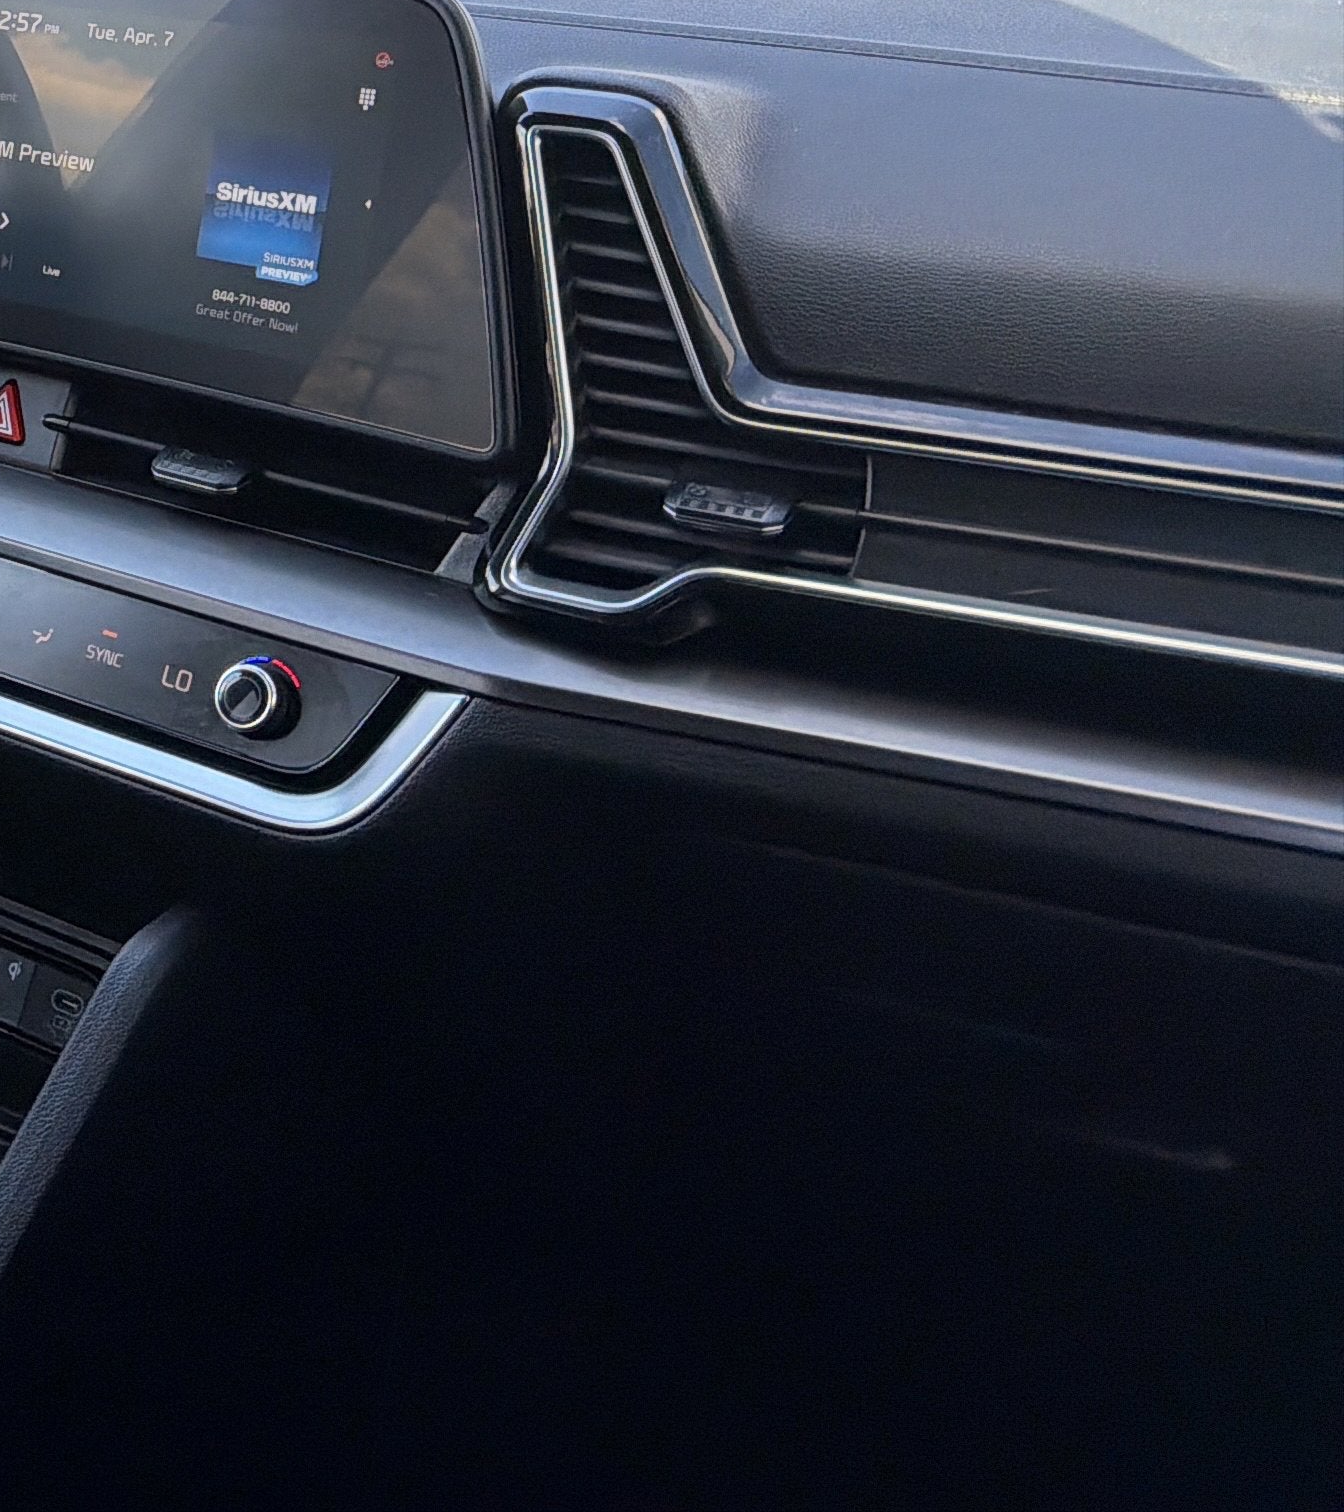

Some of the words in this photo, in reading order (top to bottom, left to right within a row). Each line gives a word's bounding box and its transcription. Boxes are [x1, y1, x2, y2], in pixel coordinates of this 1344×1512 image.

[44, 23, 60, 36] PM
[123, 28, 158, 49] Apr.
[163, 30, 175, 48] 7
[18, 143, 95, 173] Preview
[216, 181, 318, 216] SiriusXM
[41, 264, 61, 278] Live
[262, 251, 315, 270] SIRIUSXM
[260, 265, 310, 284] PREVIEW
[212, 289, 291, 315] 844-711-8800
[195, 304, 231, 323] Great
[233, 310, 267, 329] Offer
[269, 316, 299, 336] Now!
[85, 644, 125, 668] SYNC
[161, 664, 193, 694] LO
